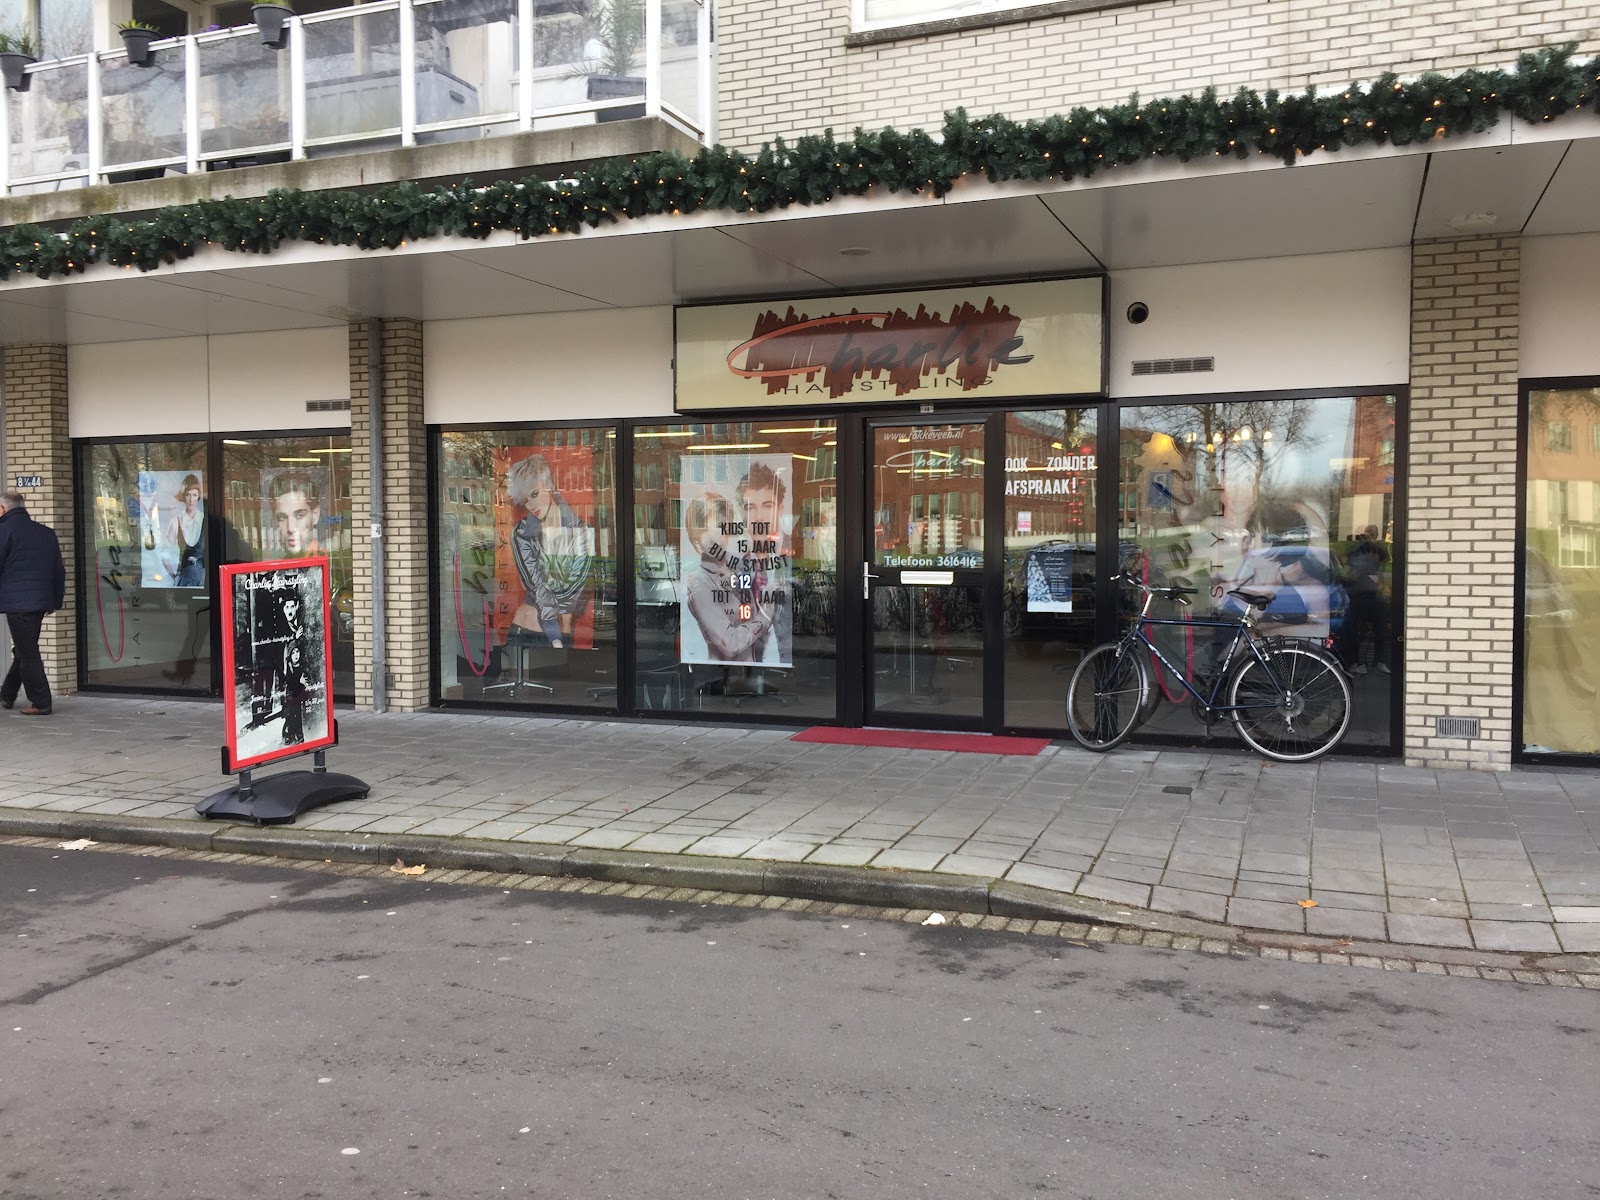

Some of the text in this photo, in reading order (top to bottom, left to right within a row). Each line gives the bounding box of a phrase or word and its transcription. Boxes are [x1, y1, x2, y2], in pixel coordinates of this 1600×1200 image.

[727, 312, 1035, 377] Charlie
[783, 375, 994, 395] HAIRSTYLING
[885, 449, 973, 468] Charlie
[1005, 456, 1096, 473] OOK ZONDER
[1005, 478, 1076, 495] AFSPRAAK!
[721, 522, 770, 535] KIDS TOT
[737, 540, 776, 553] 15 JAAR
[709, 542, 726, 561] BIJ
[743, 554, 788, 572] STYLIST
[883, 555, 977, 567] Telefoon 3616416
[712, 590, 730, 603] TOT
[758, 590, 786, 605] JAAR
[739, 605, 751, 619] 16
